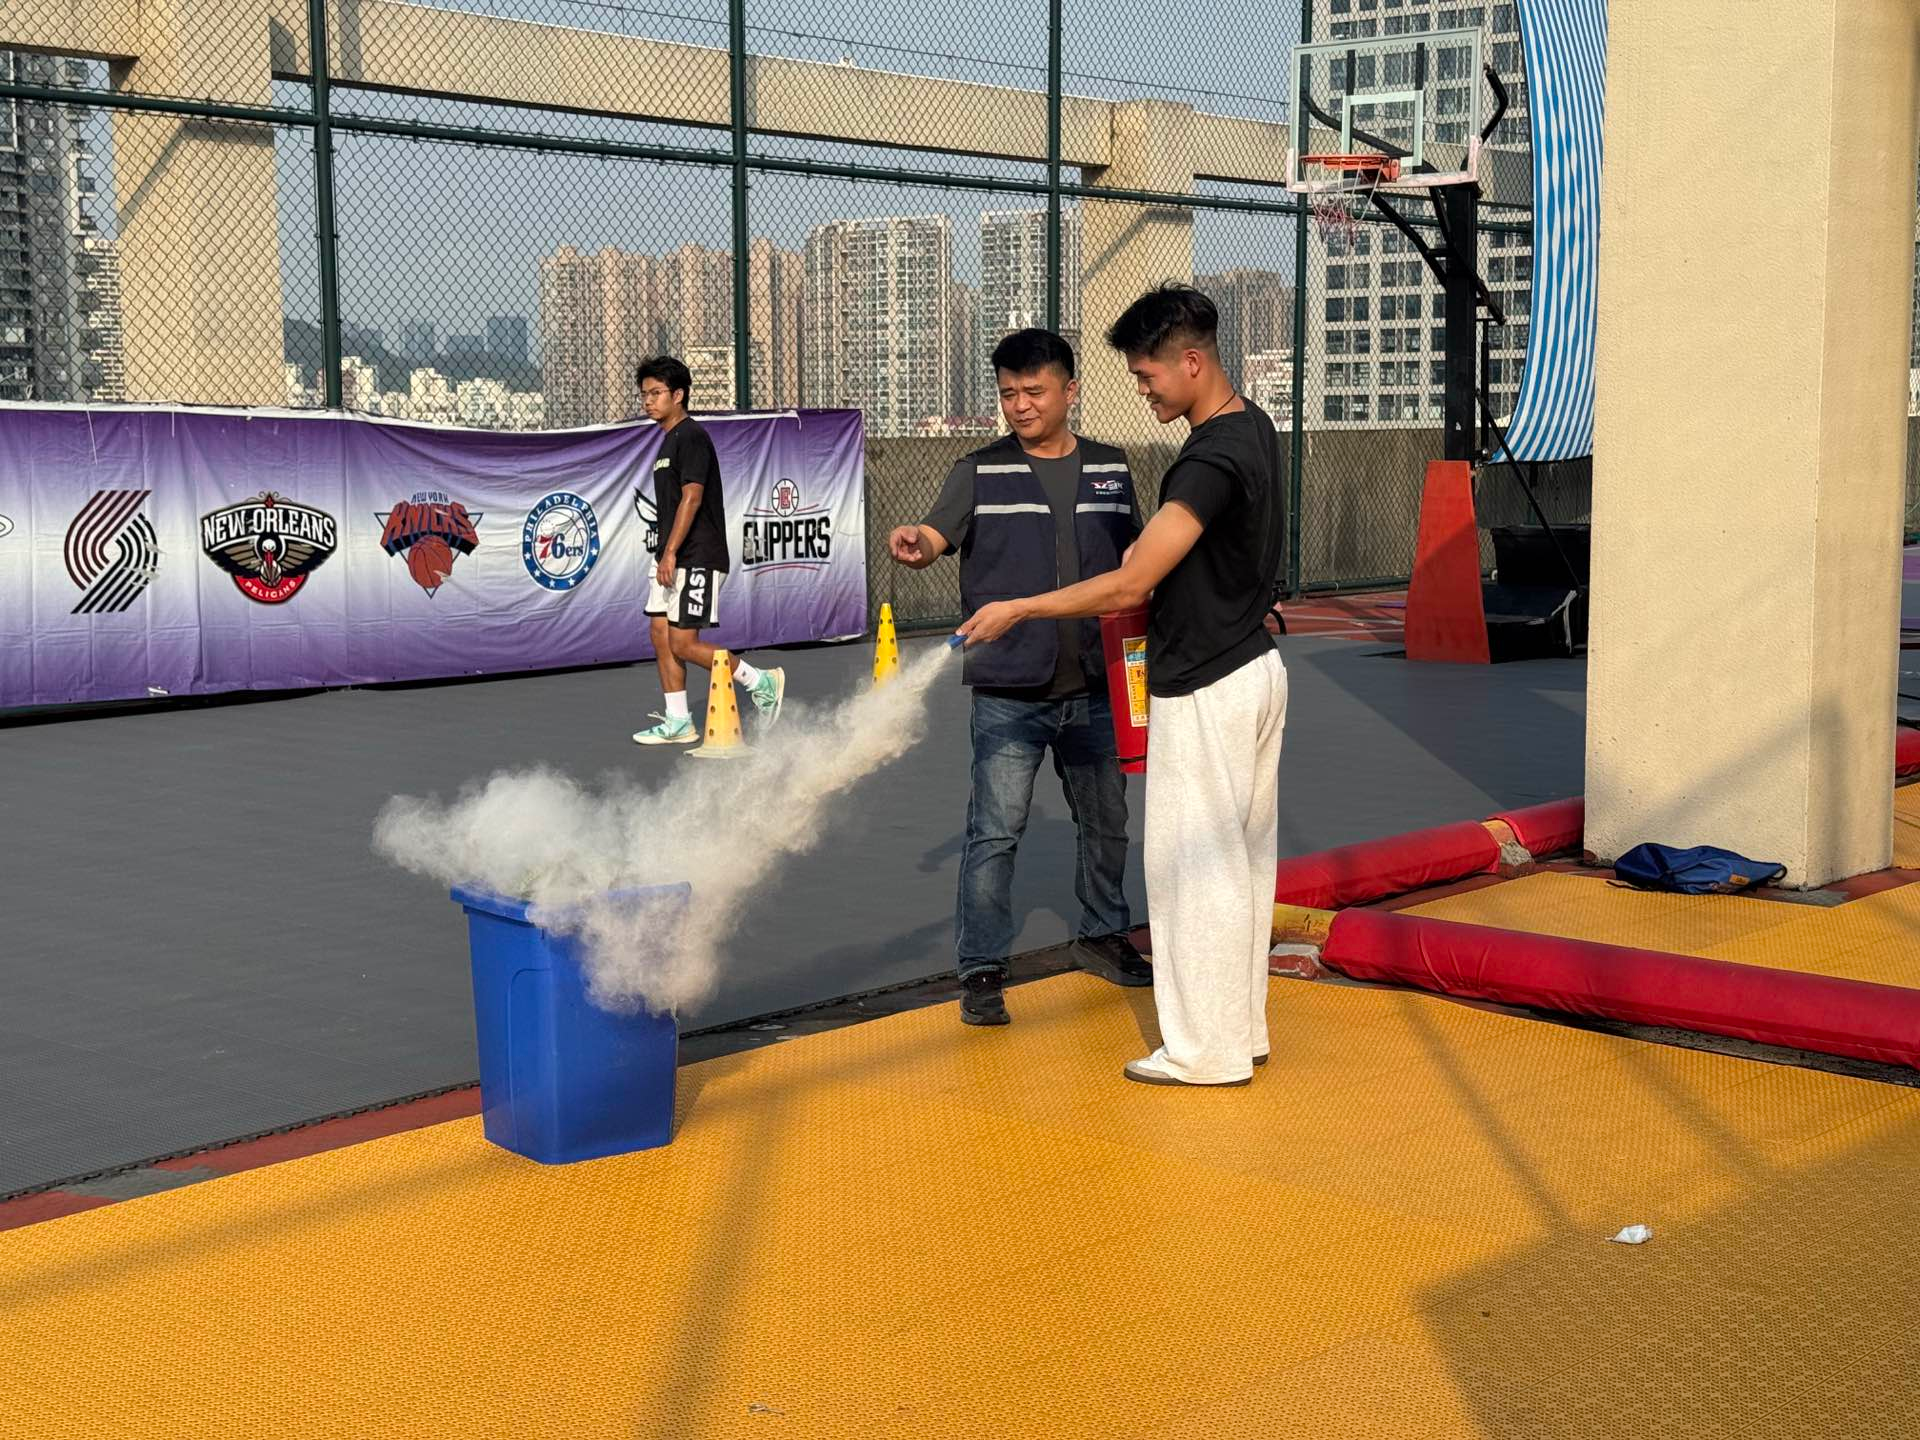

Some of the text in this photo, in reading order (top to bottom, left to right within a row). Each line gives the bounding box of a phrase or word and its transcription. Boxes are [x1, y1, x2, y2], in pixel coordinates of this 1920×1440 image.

[411, 491, 449, 503] NEW YORK
[203, 508, 335, 549] NEW ORLEANS
[380, 500, 480, 556] KNICKS
[525, 495, 598, 542] PHILADELPHIA
[536, 533, 584, 559] 76ers
[743, 516, 830, 565] CLIPPERS
[245, 580, 297, 598] PELICANS
